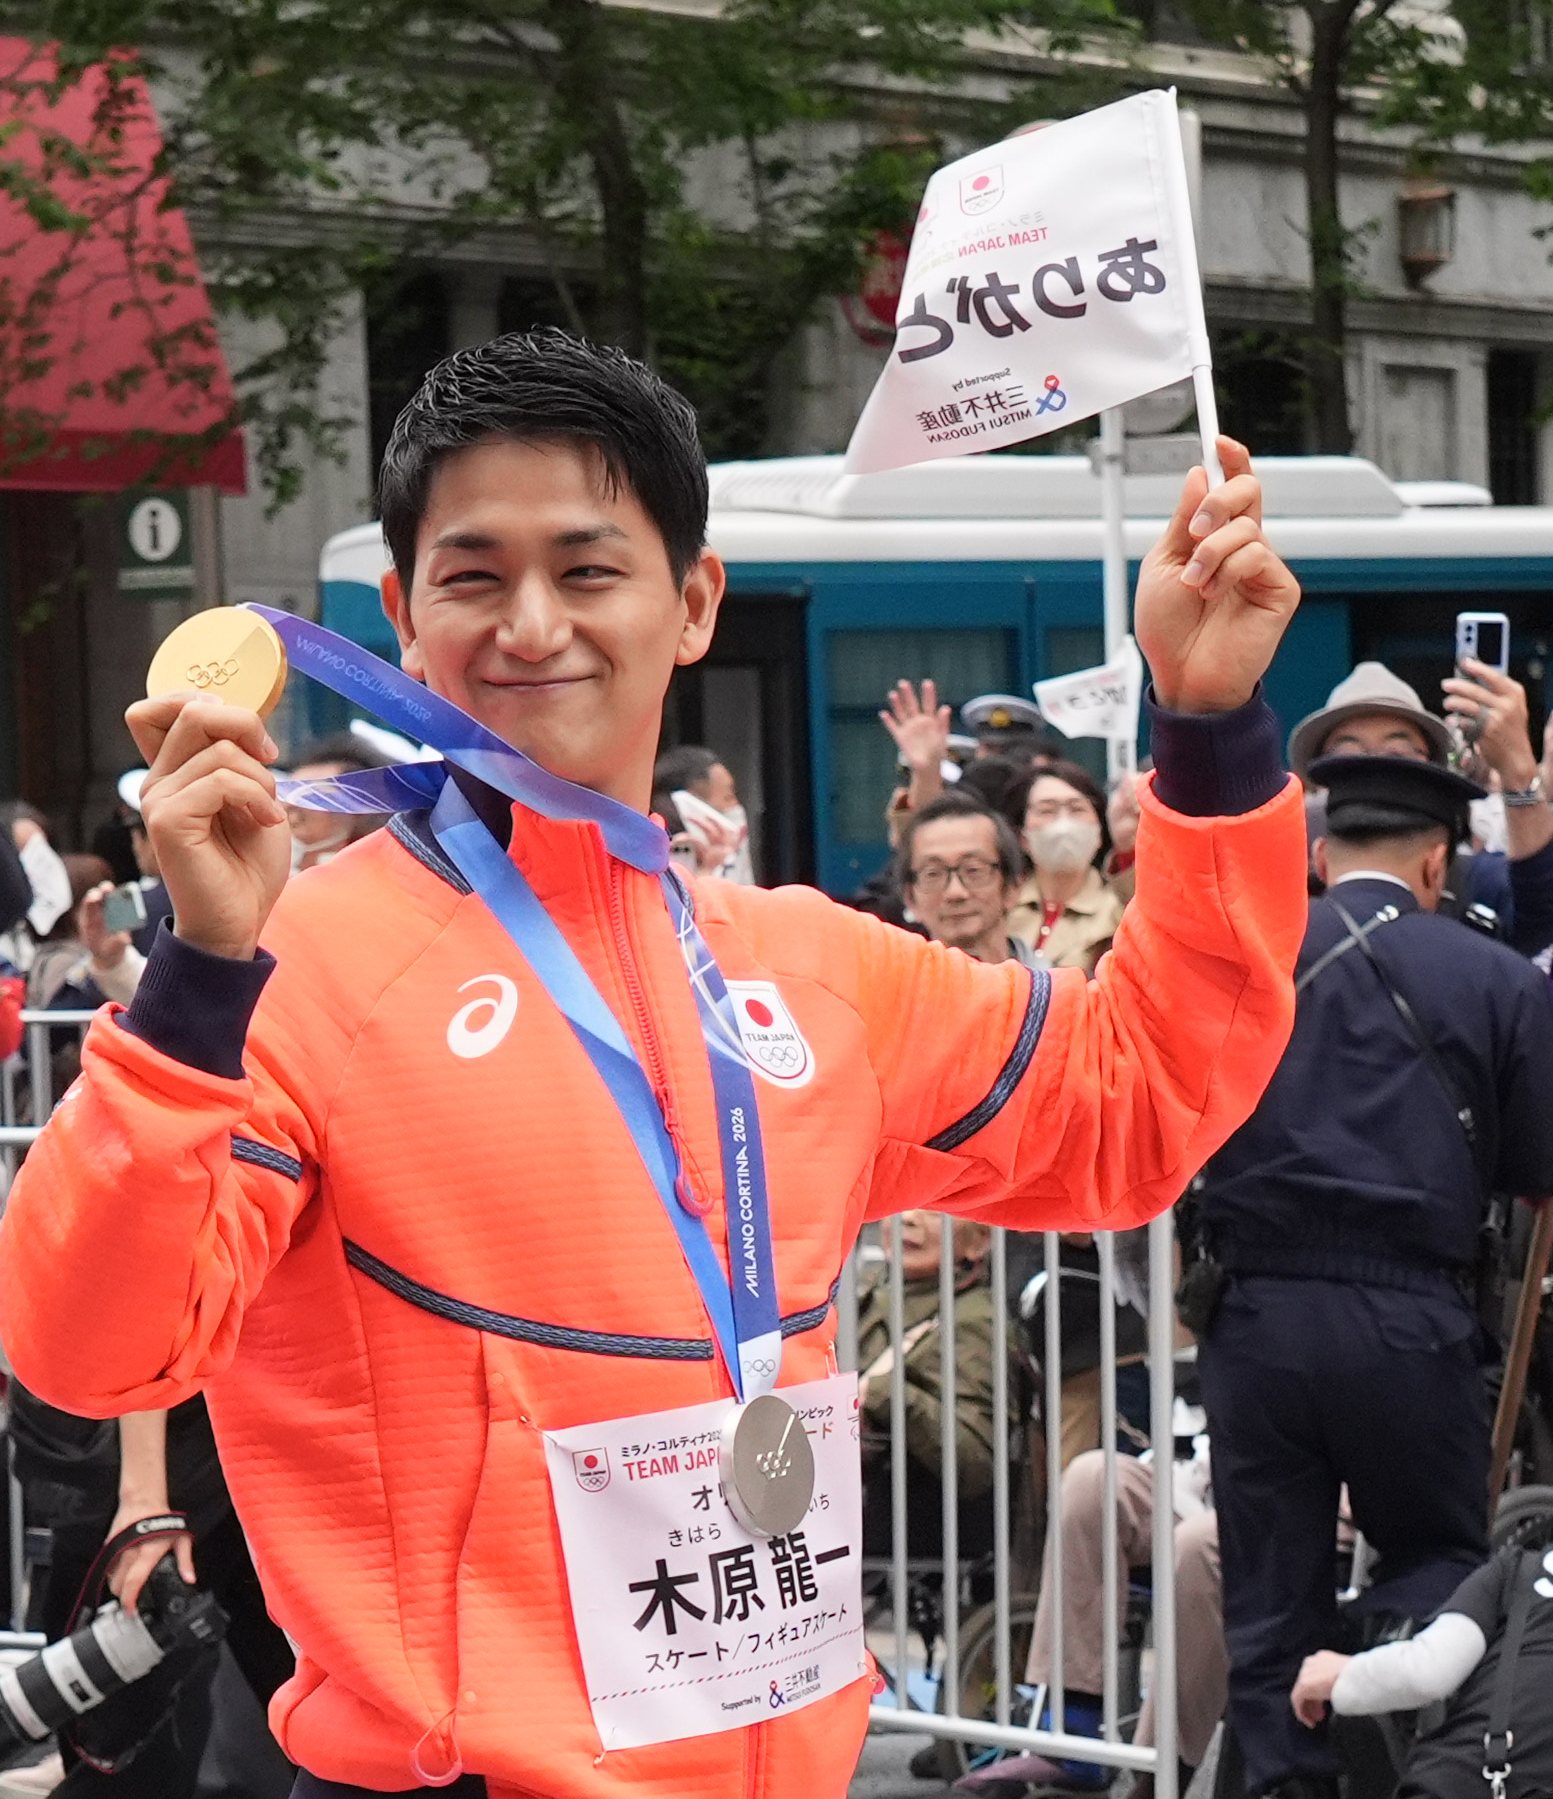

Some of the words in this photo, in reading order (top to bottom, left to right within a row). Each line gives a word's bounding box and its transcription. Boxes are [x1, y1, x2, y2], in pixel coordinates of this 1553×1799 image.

[745, 1033, 770, 1042] TEAM
[730, 1106, 747, 1143] 2026
[735, 1145, 754, 1222] CORTINA
[741, 1224, 759, 1298] MILANO
[623, 1454, 680, 1481] TEAM
[684, 1446, 719, 1473] JAP
[668, 1522, 722, 1548] きはら
